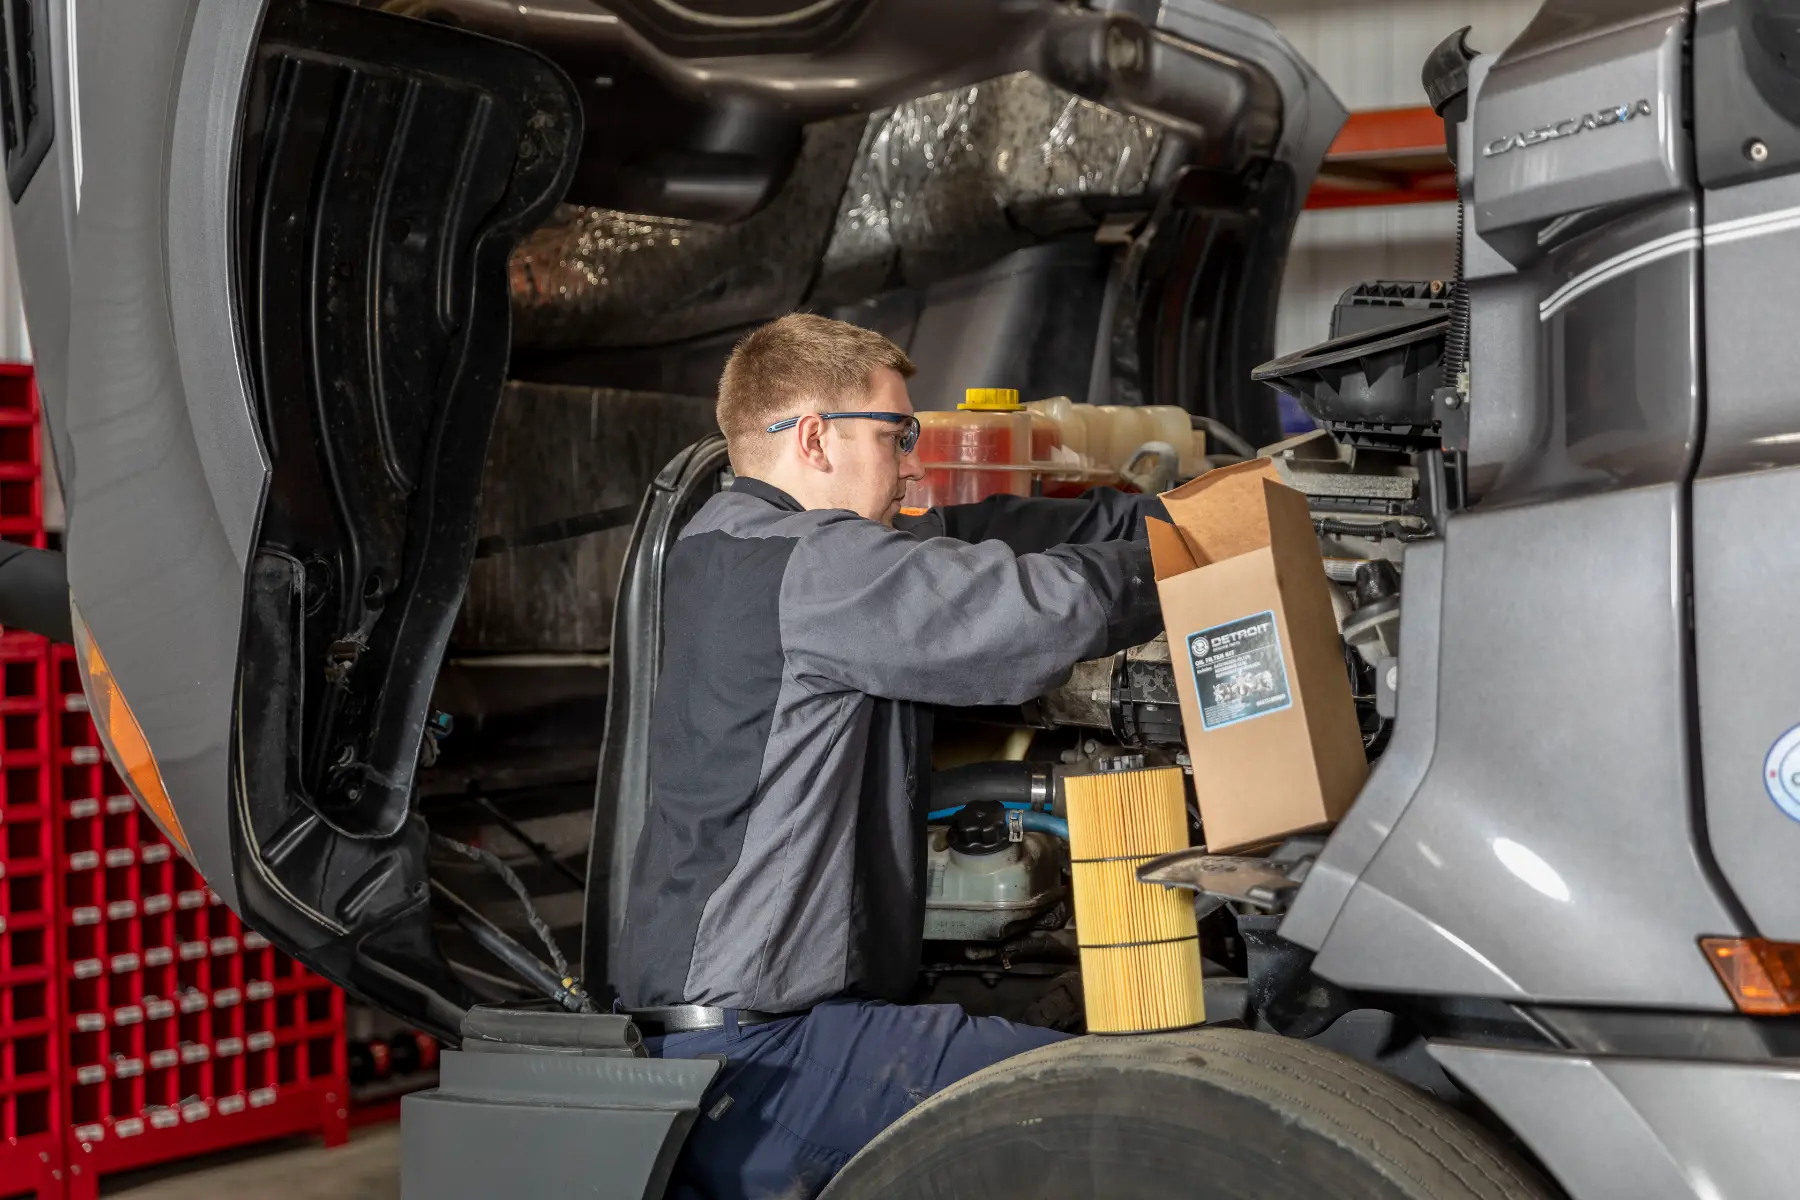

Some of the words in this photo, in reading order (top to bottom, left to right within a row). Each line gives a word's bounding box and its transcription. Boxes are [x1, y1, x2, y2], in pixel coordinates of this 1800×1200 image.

[1483, 99, 1651, 157] CASCADIA
[1210, 622, 1272, 647] DETROIT
[1194, 658, 1205, 666] OIL
[1205, 652, 1225, 663] FILTER
[1224, 649, 1235, 657] KIT
